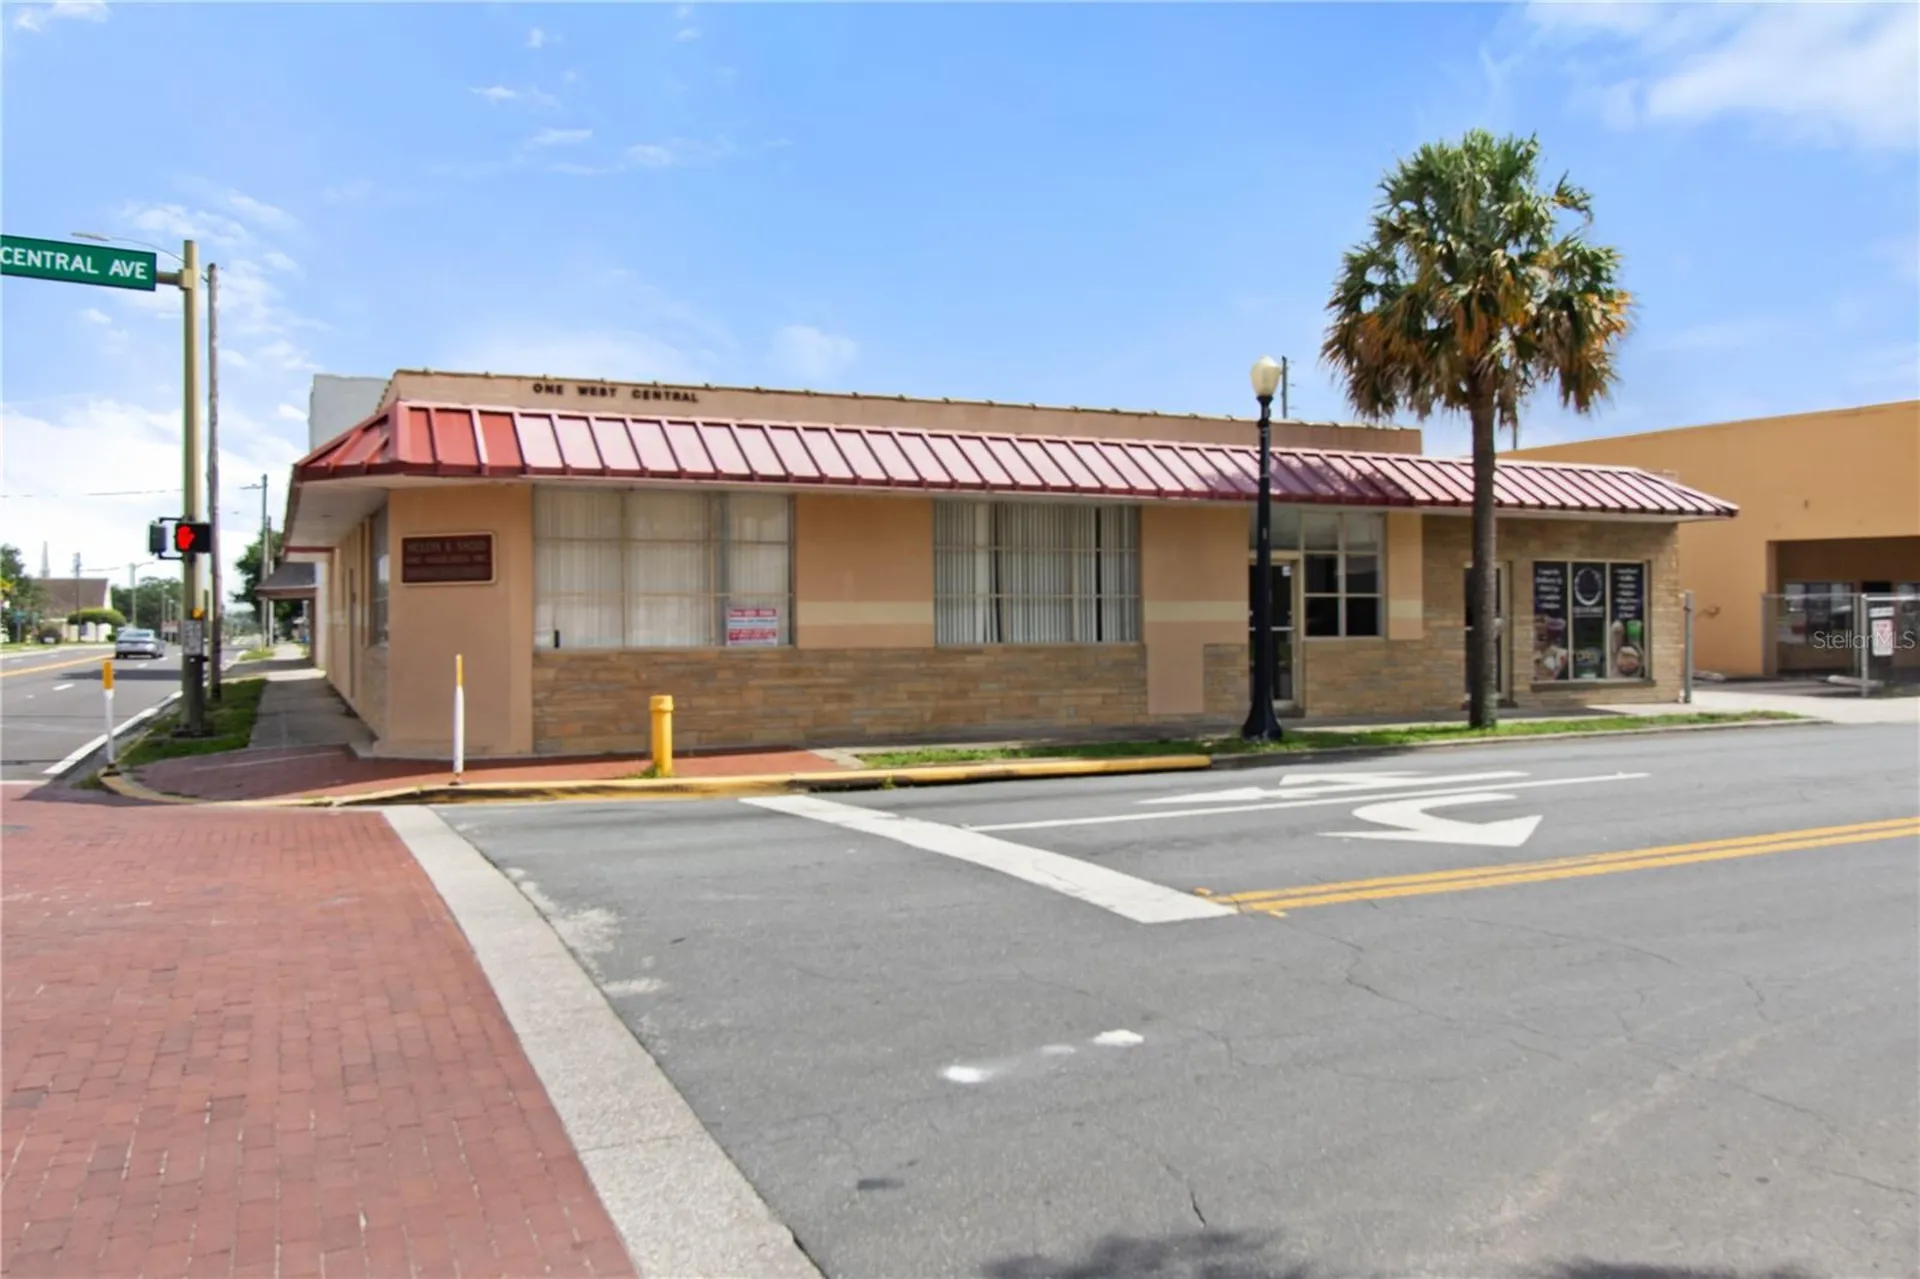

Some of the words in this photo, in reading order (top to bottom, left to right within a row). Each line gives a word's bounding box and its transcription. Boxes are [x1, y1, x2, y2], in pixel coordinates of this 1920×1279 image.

[0, 246, 99, 274] CENTRAL
[108, 258, 148, 280] AVE
[532, 383, 564, 395] ONE
[577, 385, 617, 398] WEST
[631, 388, 699, 403] CENTRAL
